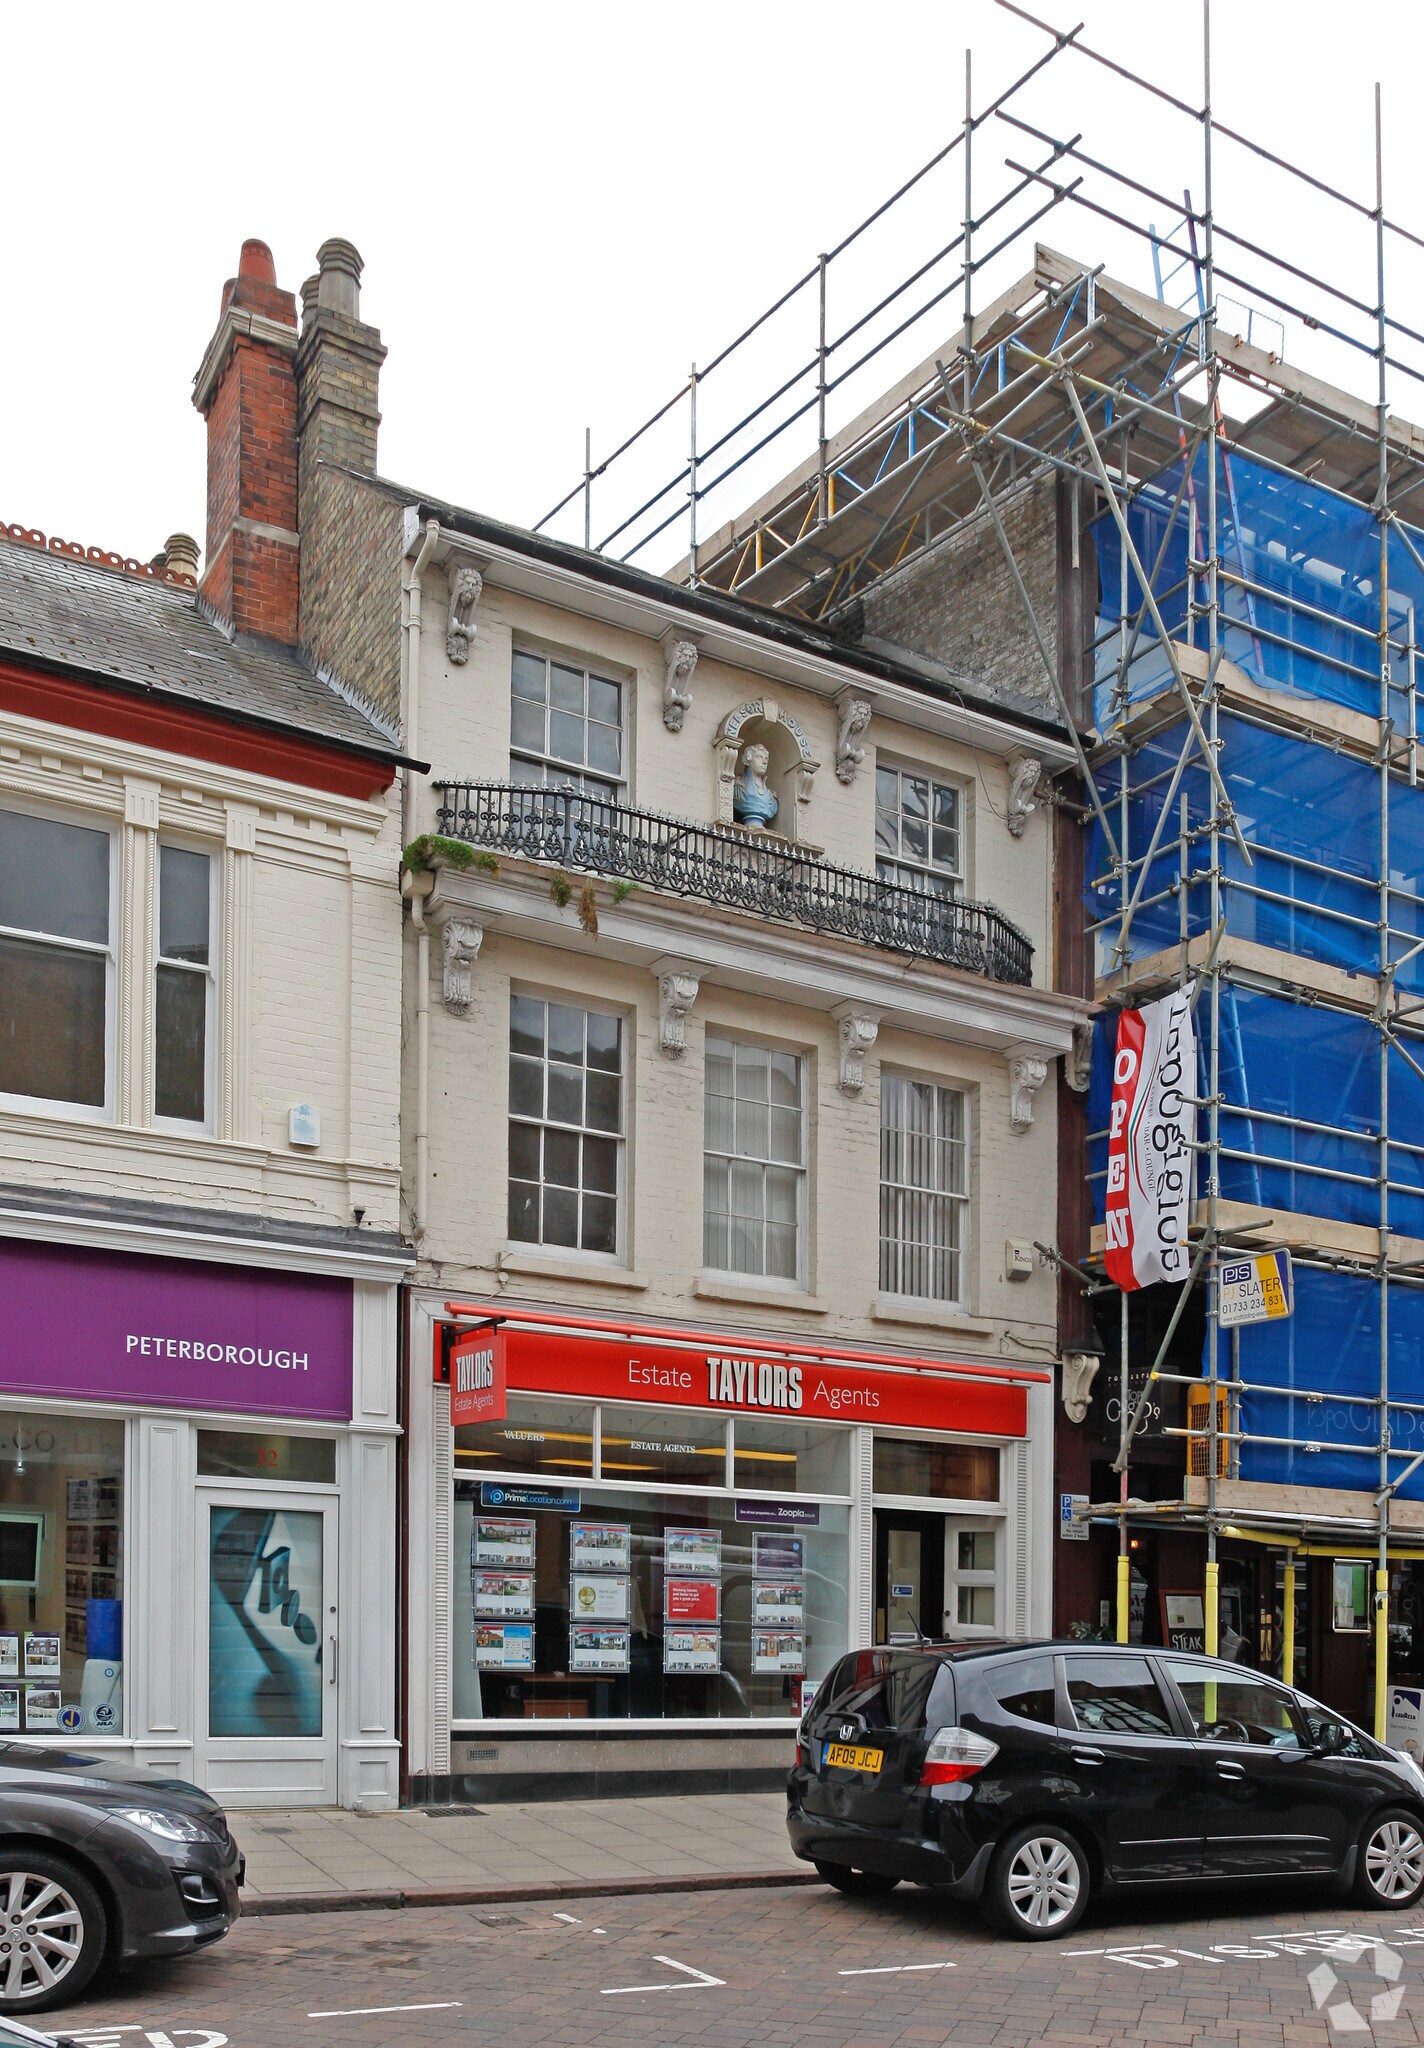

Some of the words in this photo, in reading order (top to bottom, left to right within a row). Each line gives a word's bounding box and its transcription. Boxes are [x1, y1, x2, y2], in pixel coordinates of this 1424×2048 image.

[1143, 1125, 1151, 1146] BAR
[1104, 1048, 1138, 1251] OPEN
[1145, 1152, 1156, 1193] LOUNGE
[1225, 1265, 1251, 1283] PJS
[1223, 1287, 1235, 1300] PJ
[1239, 1277, 1282, 1298] SLATER
[1222, 1302, 1248, 1315] 01733
[1250, 1298, 1266, 1310] 234
[1268, 1294, 1284, 1306] 831
[126, 1334, 309, 1371] PETERBOROUGH
[456, 1349, 494, 1393] TAYLORS
[628, 1359, 692, 1388] Estate
[706, 1357, 803, 1409] TAYLORS
[813, 1380, 881, 1410] Agents
[454, 1397, 472, 1412] Estate
[473, 1394, 494, 1412] Agents
[503, 1429, 545, 1442] VALUERS
[256, 1448, 278, 1467] 32
[630, 1440, 661, 1452] ESTATE
[663, 1443, 696, 1454] AGENTS
[504, 1491, 572, 1506] PrimeLocation.com
[1064, 1496, 1071, 1507] P
[1171, 1632, 1204, 1651] STEAK
[828, 1746, 857, 1765] AF09
[857, 1751, 880, 1769] JCJ
